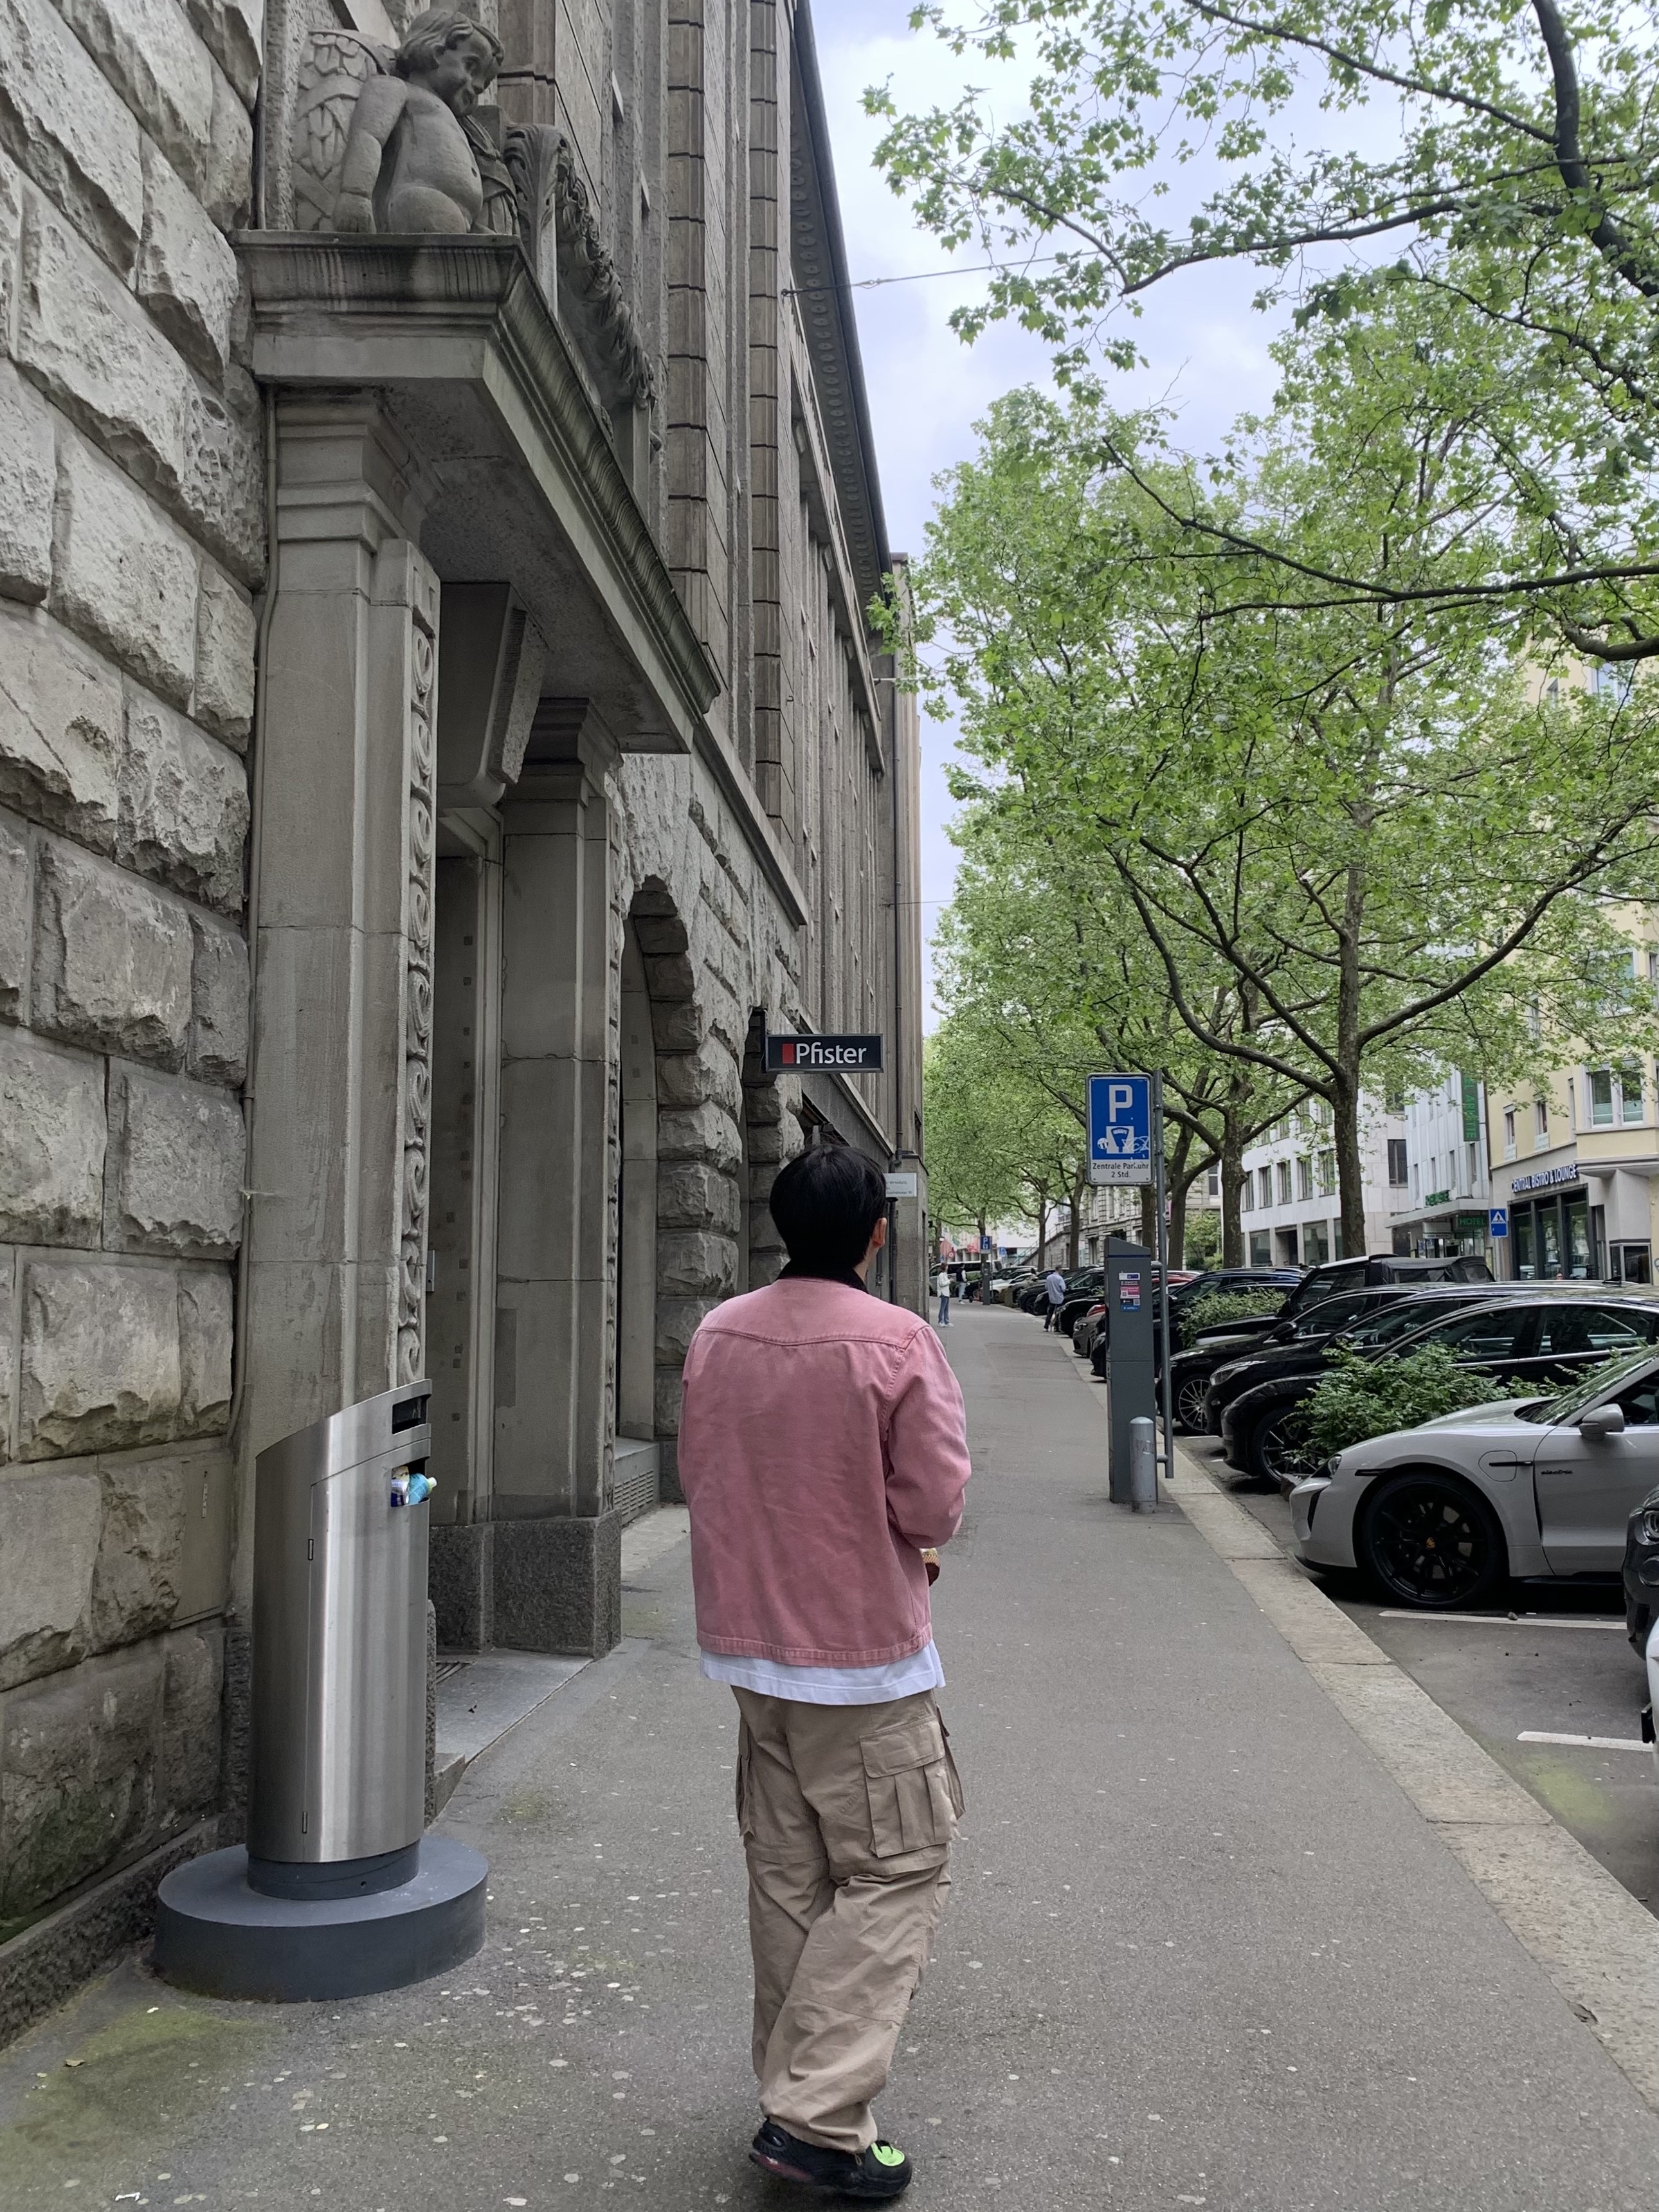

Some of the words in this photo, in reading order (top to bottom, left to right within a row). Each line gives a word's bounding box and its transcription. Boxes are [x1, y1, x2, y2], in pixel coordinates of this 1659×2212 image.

[796, 1042, 867, 1064] Pfister
[1109, 1085, 1133, 1123] P
[1511, 1175, 1532, 1193] CENTRAL
[1531, 1171, 1549, 1188] BISTRO
[1550, 1171, 1554, 1183] &
[1554, 1165, 1577, 1183] LOUNGE
[1459, 1217, 1485, 1226] HOTEL
